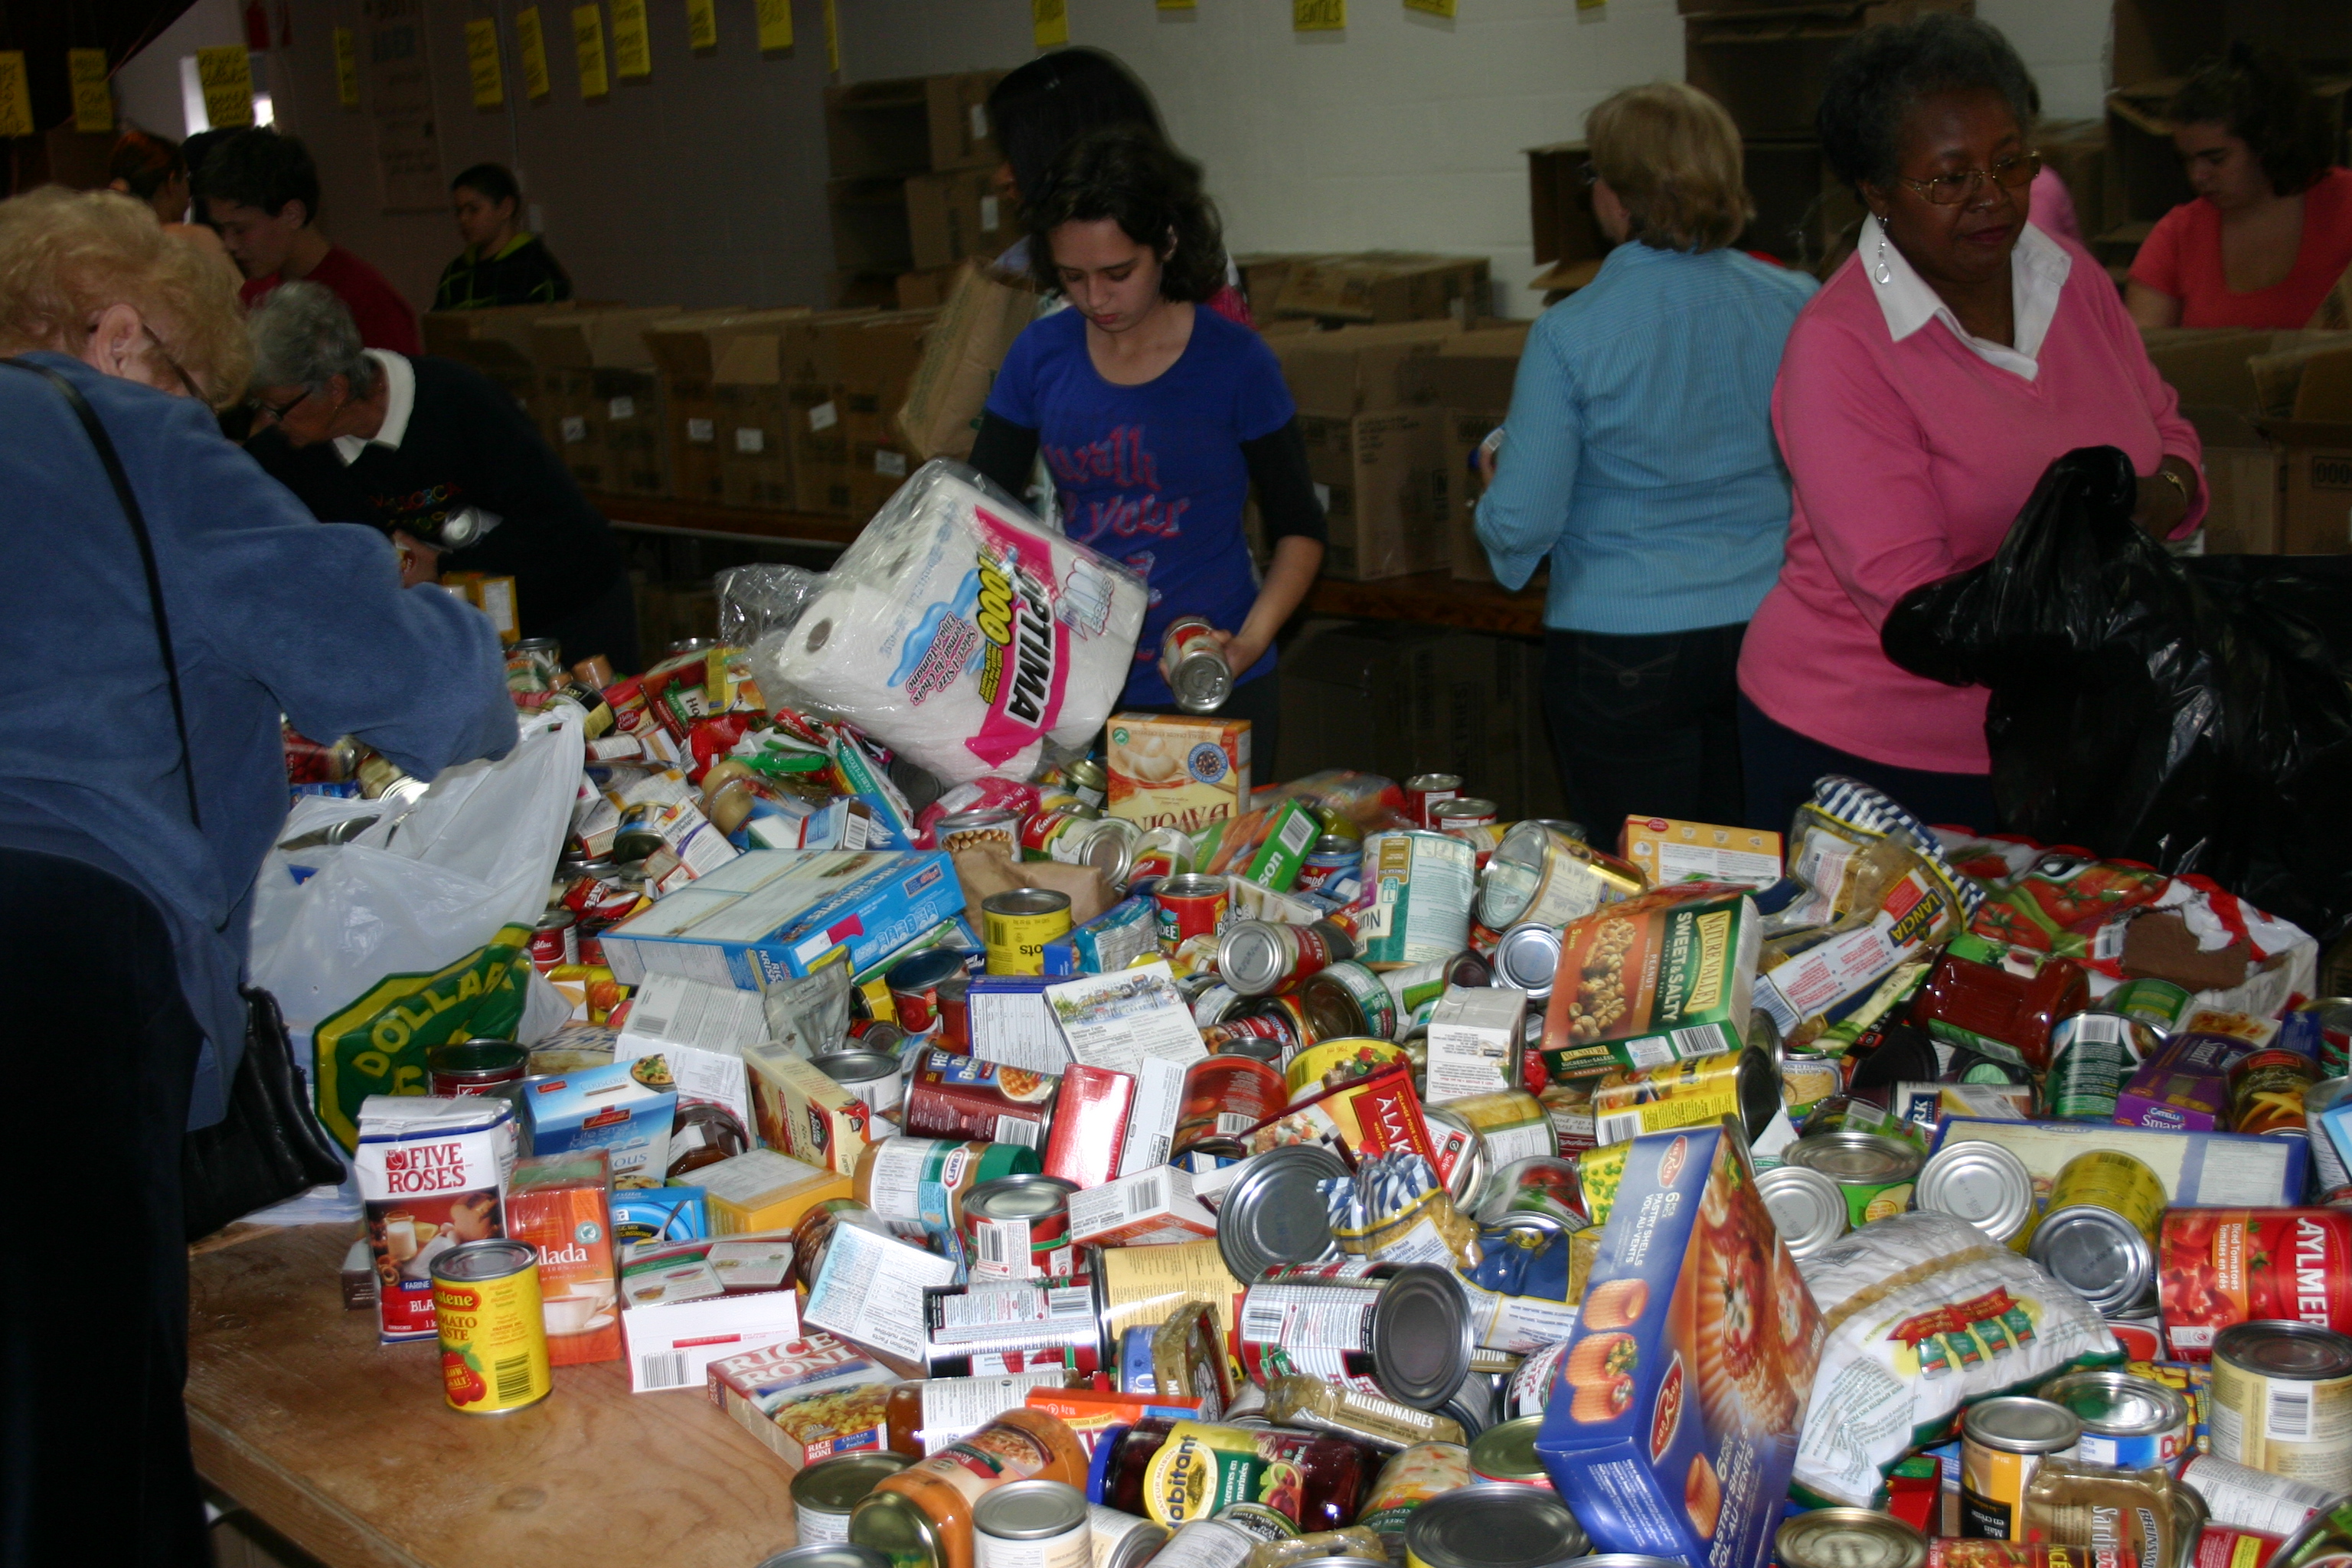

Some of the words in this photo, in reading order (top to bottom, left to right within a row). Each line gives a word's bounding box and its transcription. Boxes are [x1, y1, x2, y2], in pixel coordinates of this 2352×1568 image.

[1078, 495, 1191, 544] your
[978, 555, 1014, 646] 1000
[944, 621, 967, 659] Format
[1008, 568, 1051, 723] OPTIMA
[910, 672, 937, 704] Choix
[938, 665, 956, 690] Size
[685, 697, 700, 717] Ho
[1889, 890, 1944, 943] LANCIA
[1306, 929, 1324, 962] MER
[1672, 911, 1693, 962] SWEET
[1700, 912, 1730, 962] NATURE
[759, 949, 776, 985] KRISP
[771, 962, 783, 983] RIC
[1645, 953, 1658, 989] PEANUT
[1661, 974, 1684, 1023] SALTY
[1695, 962, 1721, 1008] VALLEY
[351, 962, 514, 1078] DOLLAR
[1579, 1046, 1609, 1058] NATURE
[579, 1074, 629, 1093] Couscous
[2148, 1106, 2184, 1122] CATELLI
[407, 1142, 463, 1170] FIVE
[948, 1150, 962, 1181] KRAFT
[387, 1168, 467, 1194] ROSES
[1664, 1191, 1680, 1203] 6
[1645, 1193, 1664, 1231] PASTRY
[1625, 1193, 1655, 1265] VOL-AU-VENTS
[2218, 1224, 2230, 1257] Tomates
[2231, 1223, 2241, 1245] Diced
[539, 1243, 589, 1265] lada
[1634, 1229, 1652, 1266] SHELLS
[2218, 1259, 2226, 1269] en
[2218, 1270, 2227, 1289] dés
[2230, 1246, 2240, 1291] Tomatoes
[2295, 1217, 2329, 1327] AYLMER
[404, 1280, 430, 1290] FARINE
[410, 1299, 436, 1312] BLA
[438, 1315, 478, 1330] MATO
[439, 1328, 470, 1341] ASTE
[717, 1331, 841, 1374] RICE
[1344, 1391, 1435, 1429] MILLIONNAIRES
[807, 1440, 831, 1452] RICE
[841, 1431, 869, 1443] Chicken
[808, 1448, 832, 1460] RONI
[1230, 1459, 1238, 1469] en
[1716, 1460, 1728, 1483] 6
[1236, 1462, 1250, 1502] marinées
[1708, 1494, 1735, 1566] PASTRY
[1727, 1424, 1749, 1494] SHELLS
